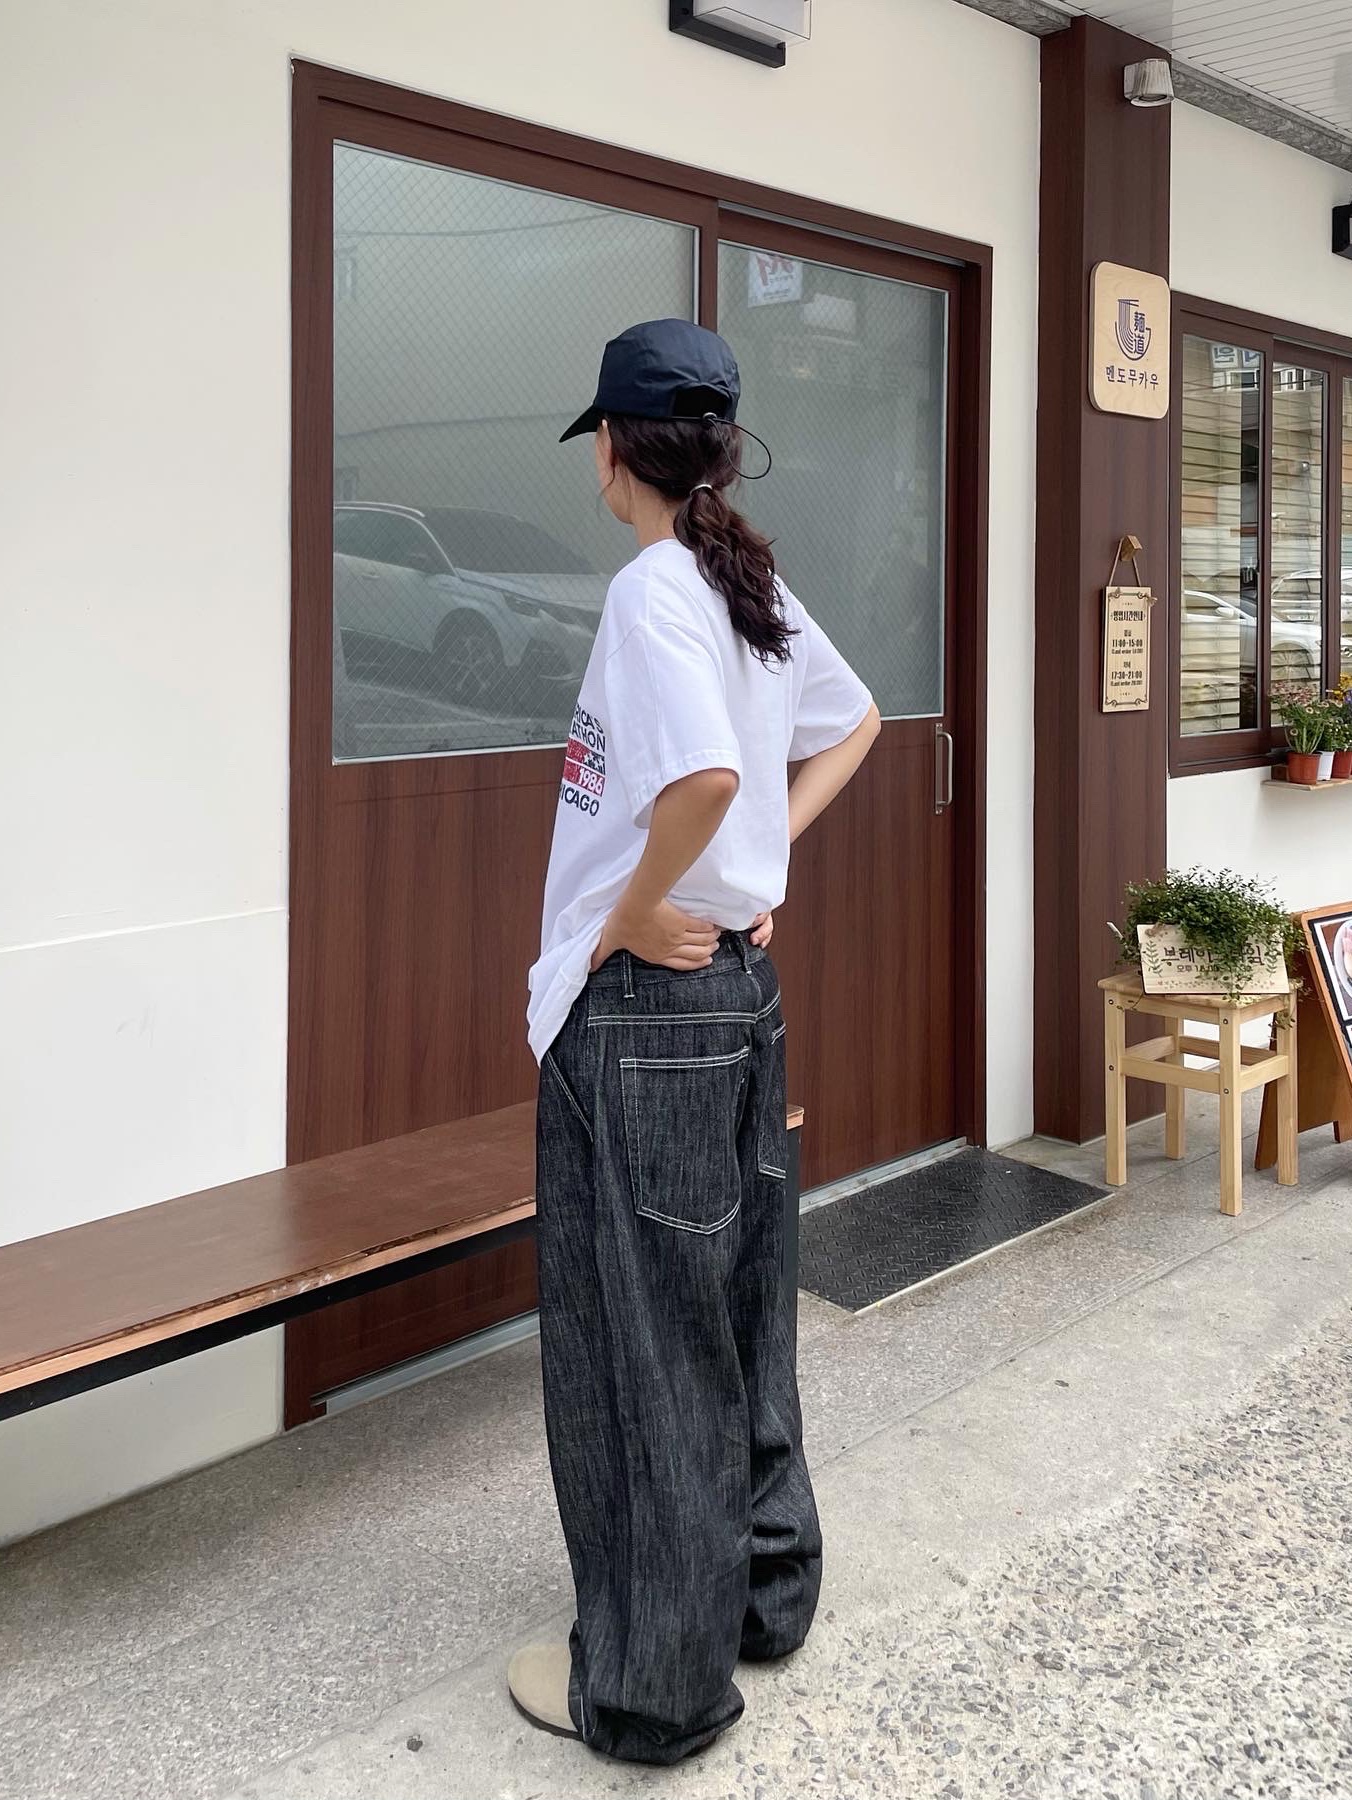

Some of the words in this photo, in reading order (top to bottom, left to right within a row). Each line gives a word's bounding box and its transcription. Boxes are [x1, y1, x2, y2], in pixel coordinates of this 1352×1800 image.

[1105, 365, 1159, 390] 멘도무카우
[579, 767, 603, 794] 1986
[560, 784, 600, 817] ICAGO
